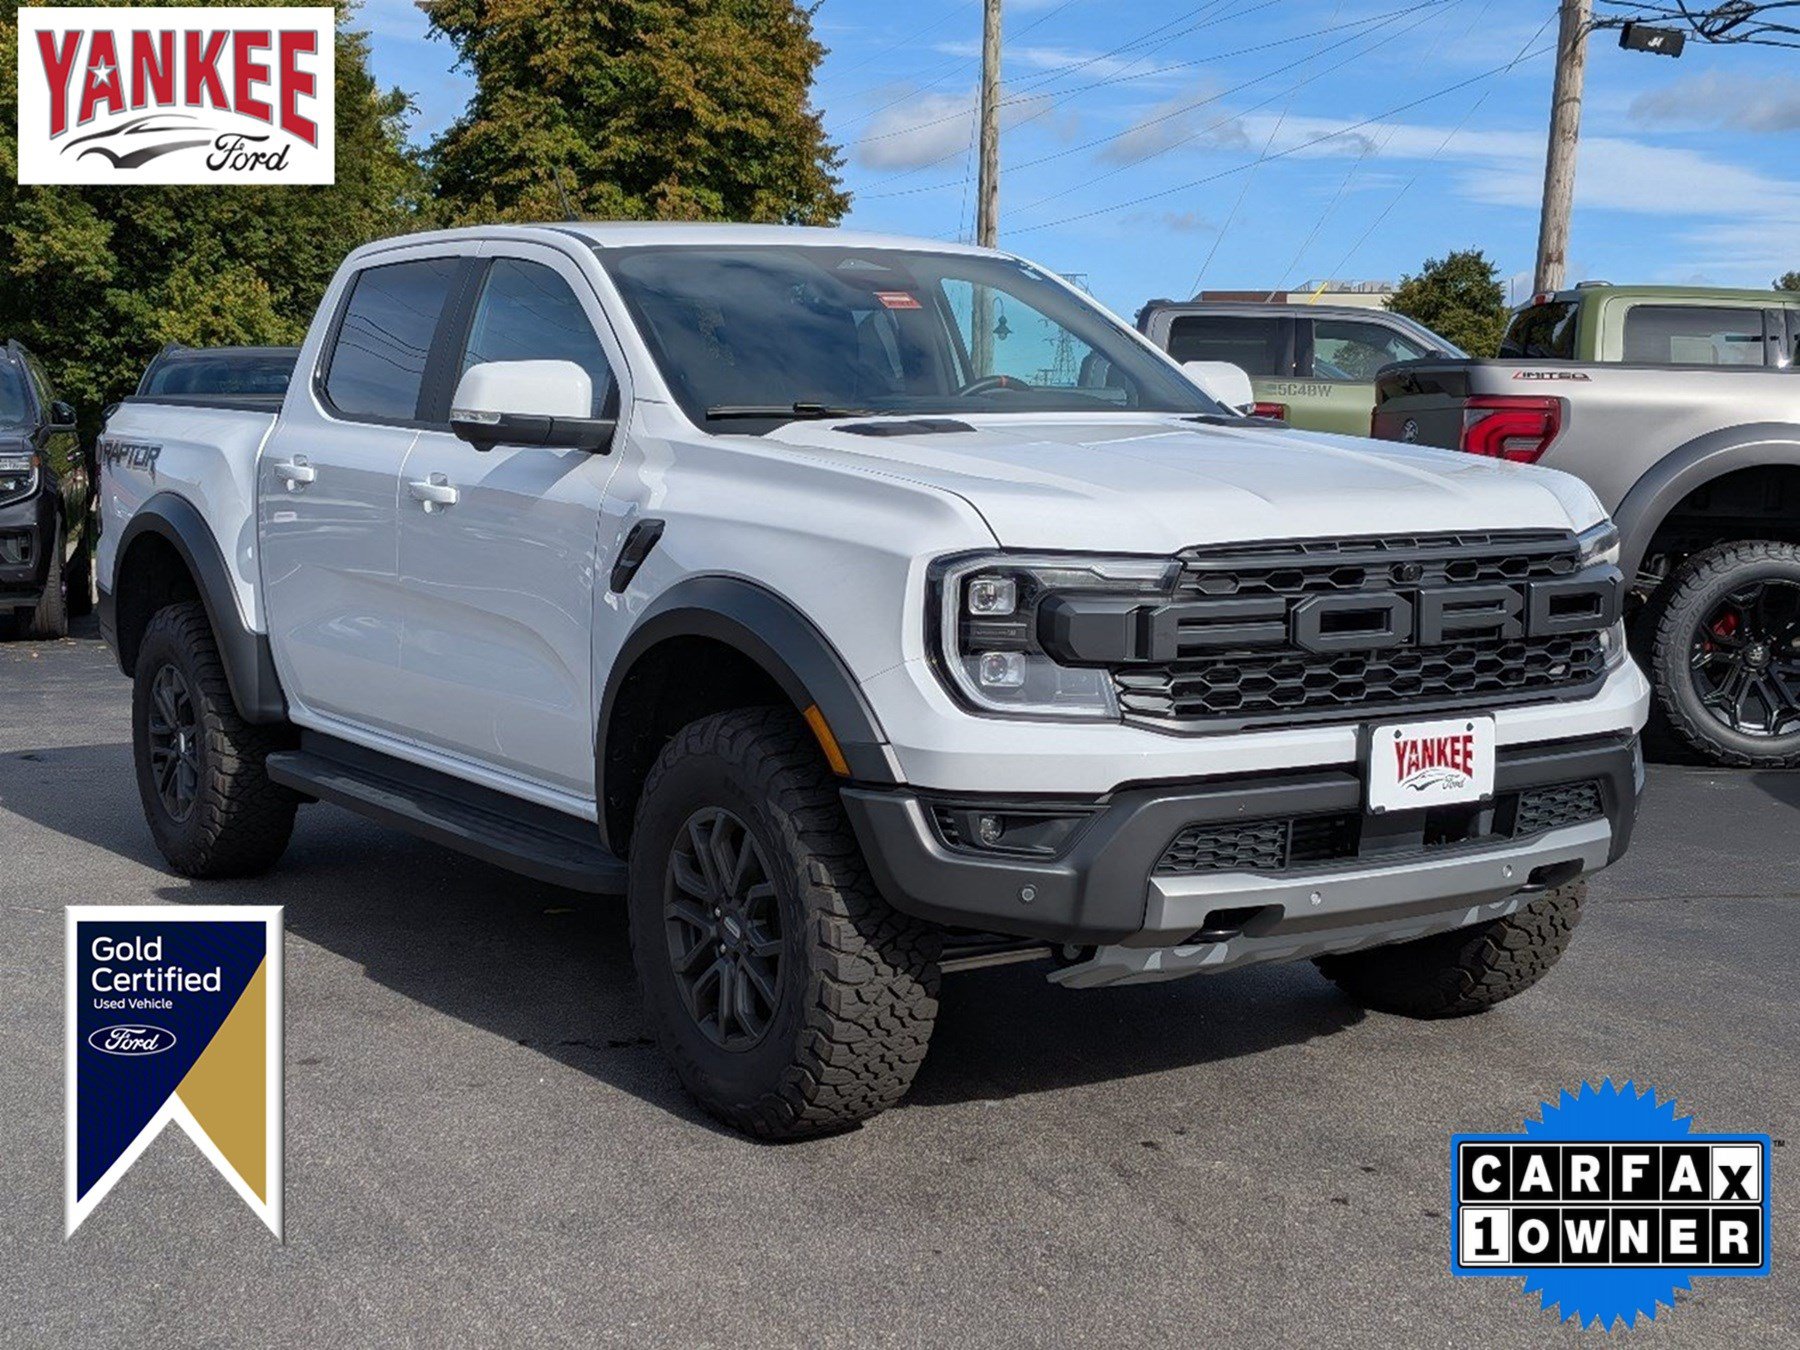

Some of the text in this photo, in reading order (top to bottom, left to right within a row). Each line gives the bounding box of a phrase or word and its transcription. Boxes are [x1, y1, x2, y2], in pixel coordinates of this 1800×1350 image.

[101, 441, 163, 484] RAPTOR
[1148, 566, 1622, 662] FORD
[1394, 735, 1474, 783] YANKEE
[1441, 774, 1466, 790] Ford
